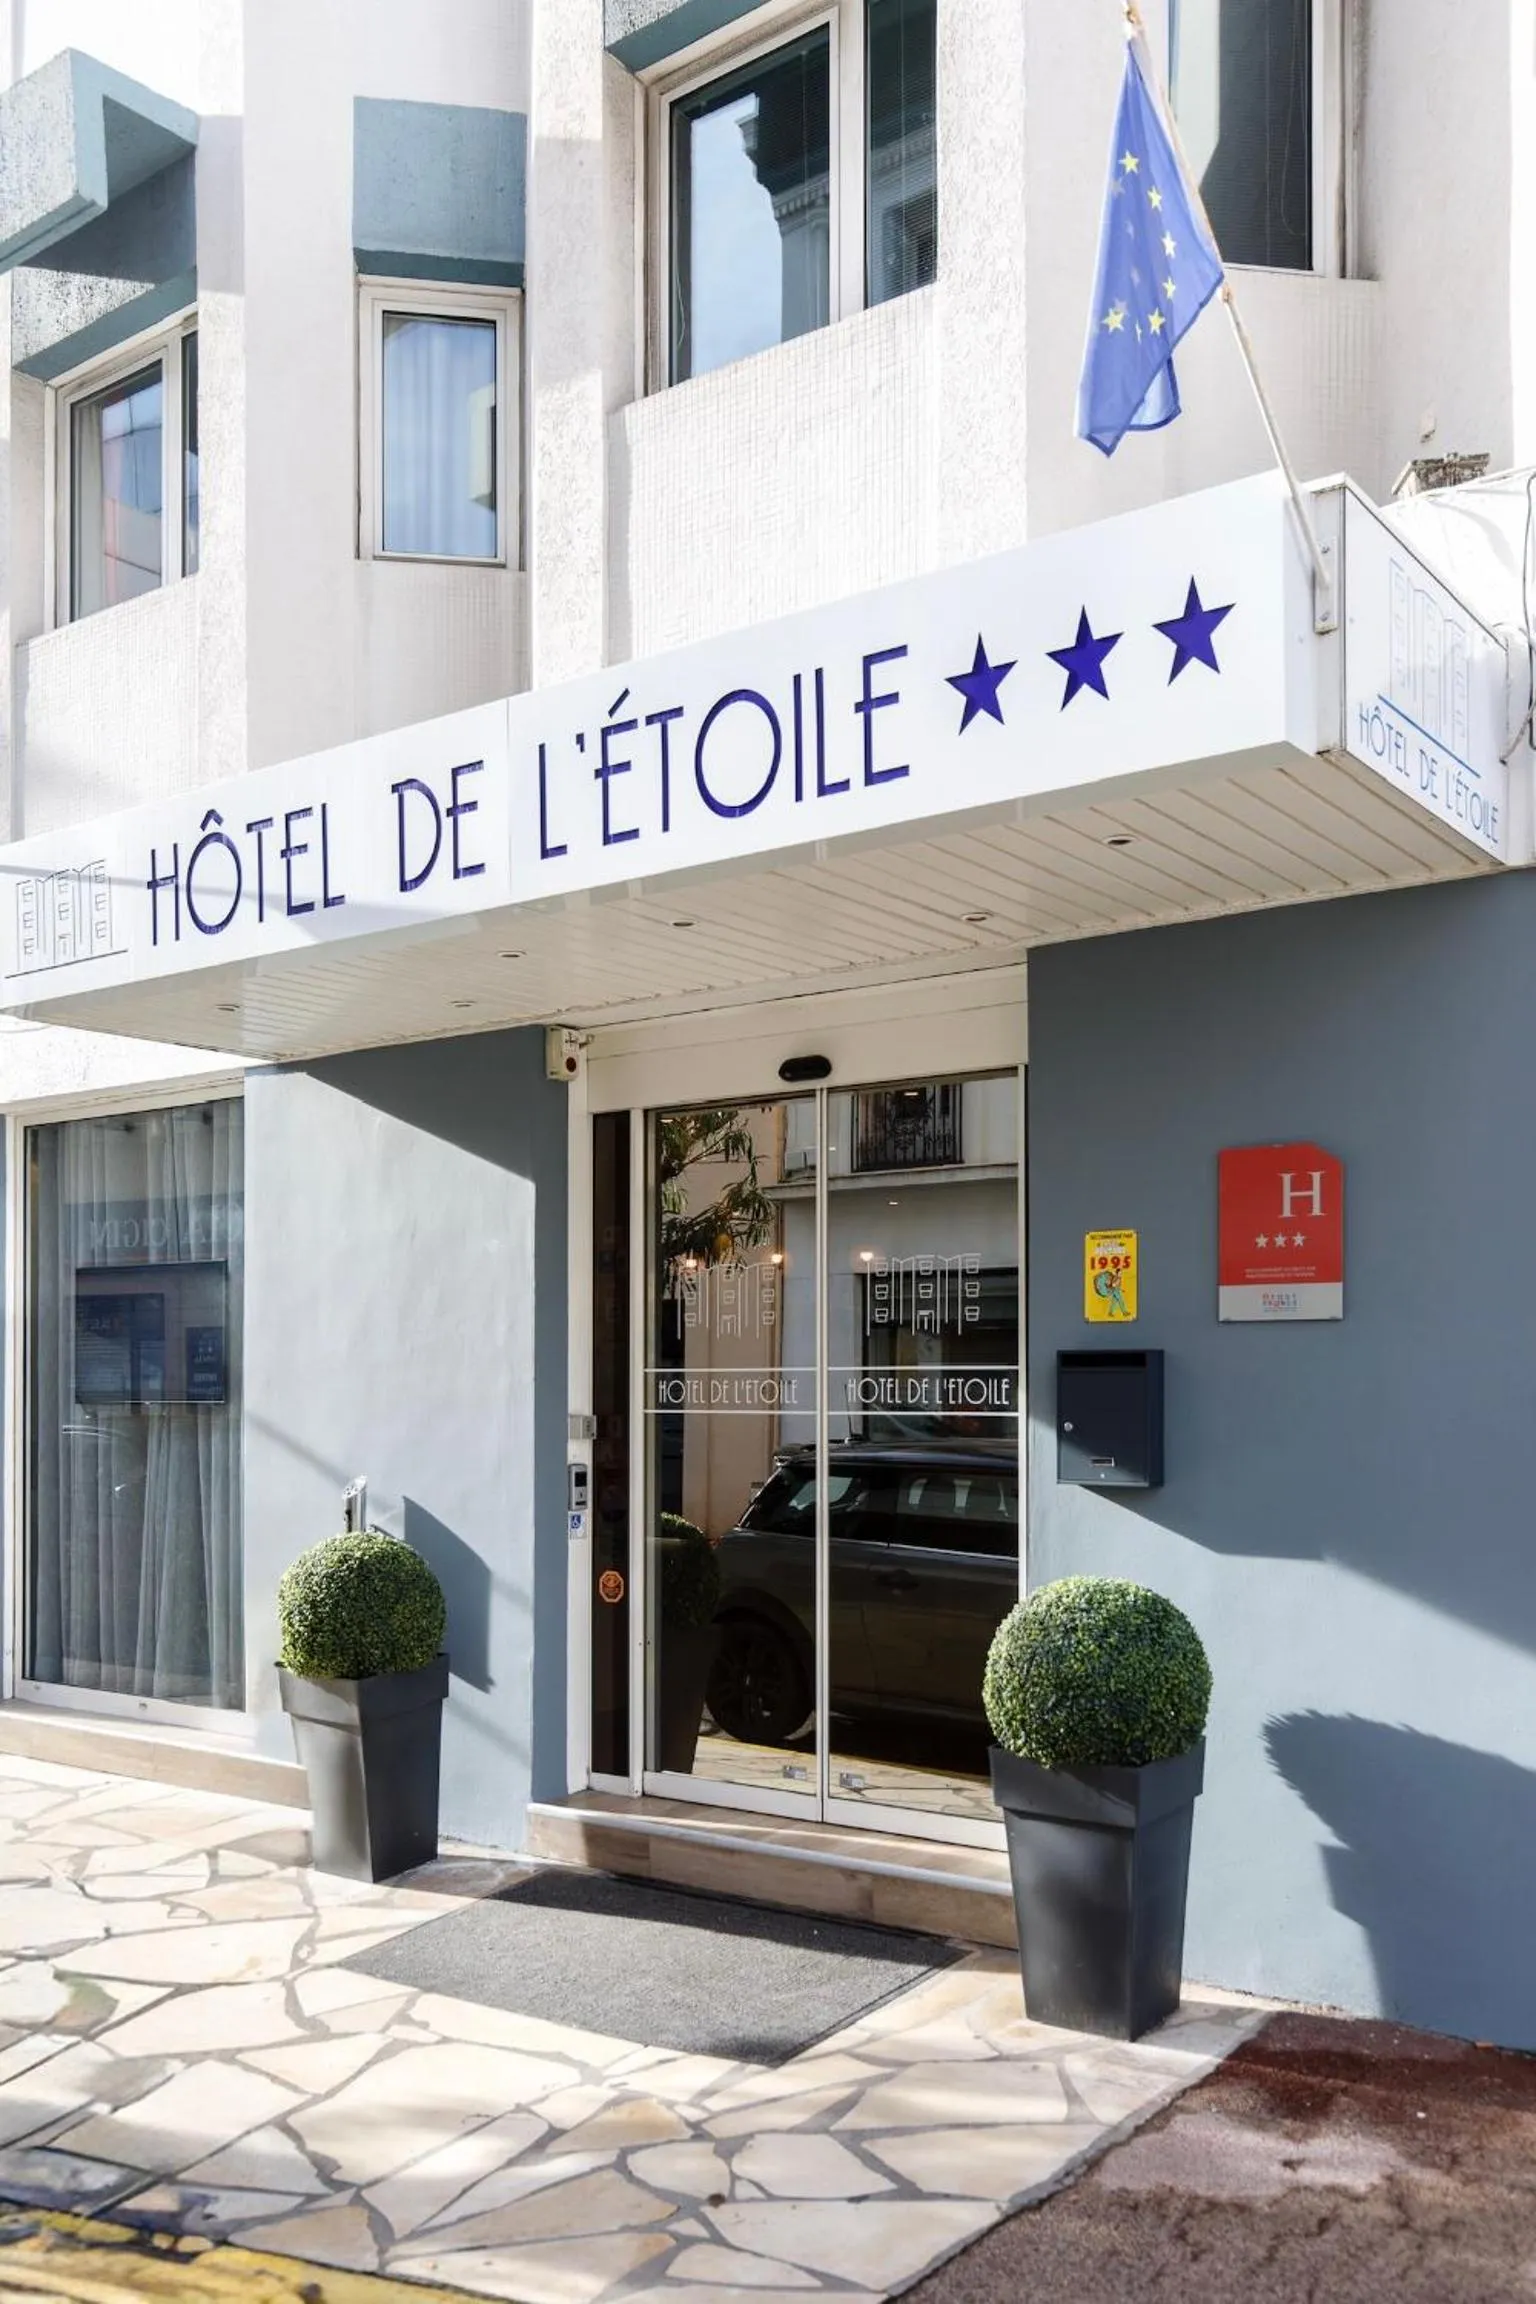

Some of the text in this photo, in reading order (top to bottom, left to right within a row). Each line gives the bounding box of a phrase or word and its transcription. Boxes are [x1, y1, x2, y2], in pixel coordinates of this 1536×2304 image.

[1359, 703, 1498, 843] HÔTEL DE L'ÉTOILE
[147, 643, 910, 946] HÔTEL DE L'ÉTOILE
[1277, 1170, 1328, 1219] H
[1090, 1255, 1132, 1270] 1995
[658, 1378, 799, 1404] HOTEL DE L'ETOILE
[847, 1377, 1010, 1405] HOTEL DE L'ETOILE
